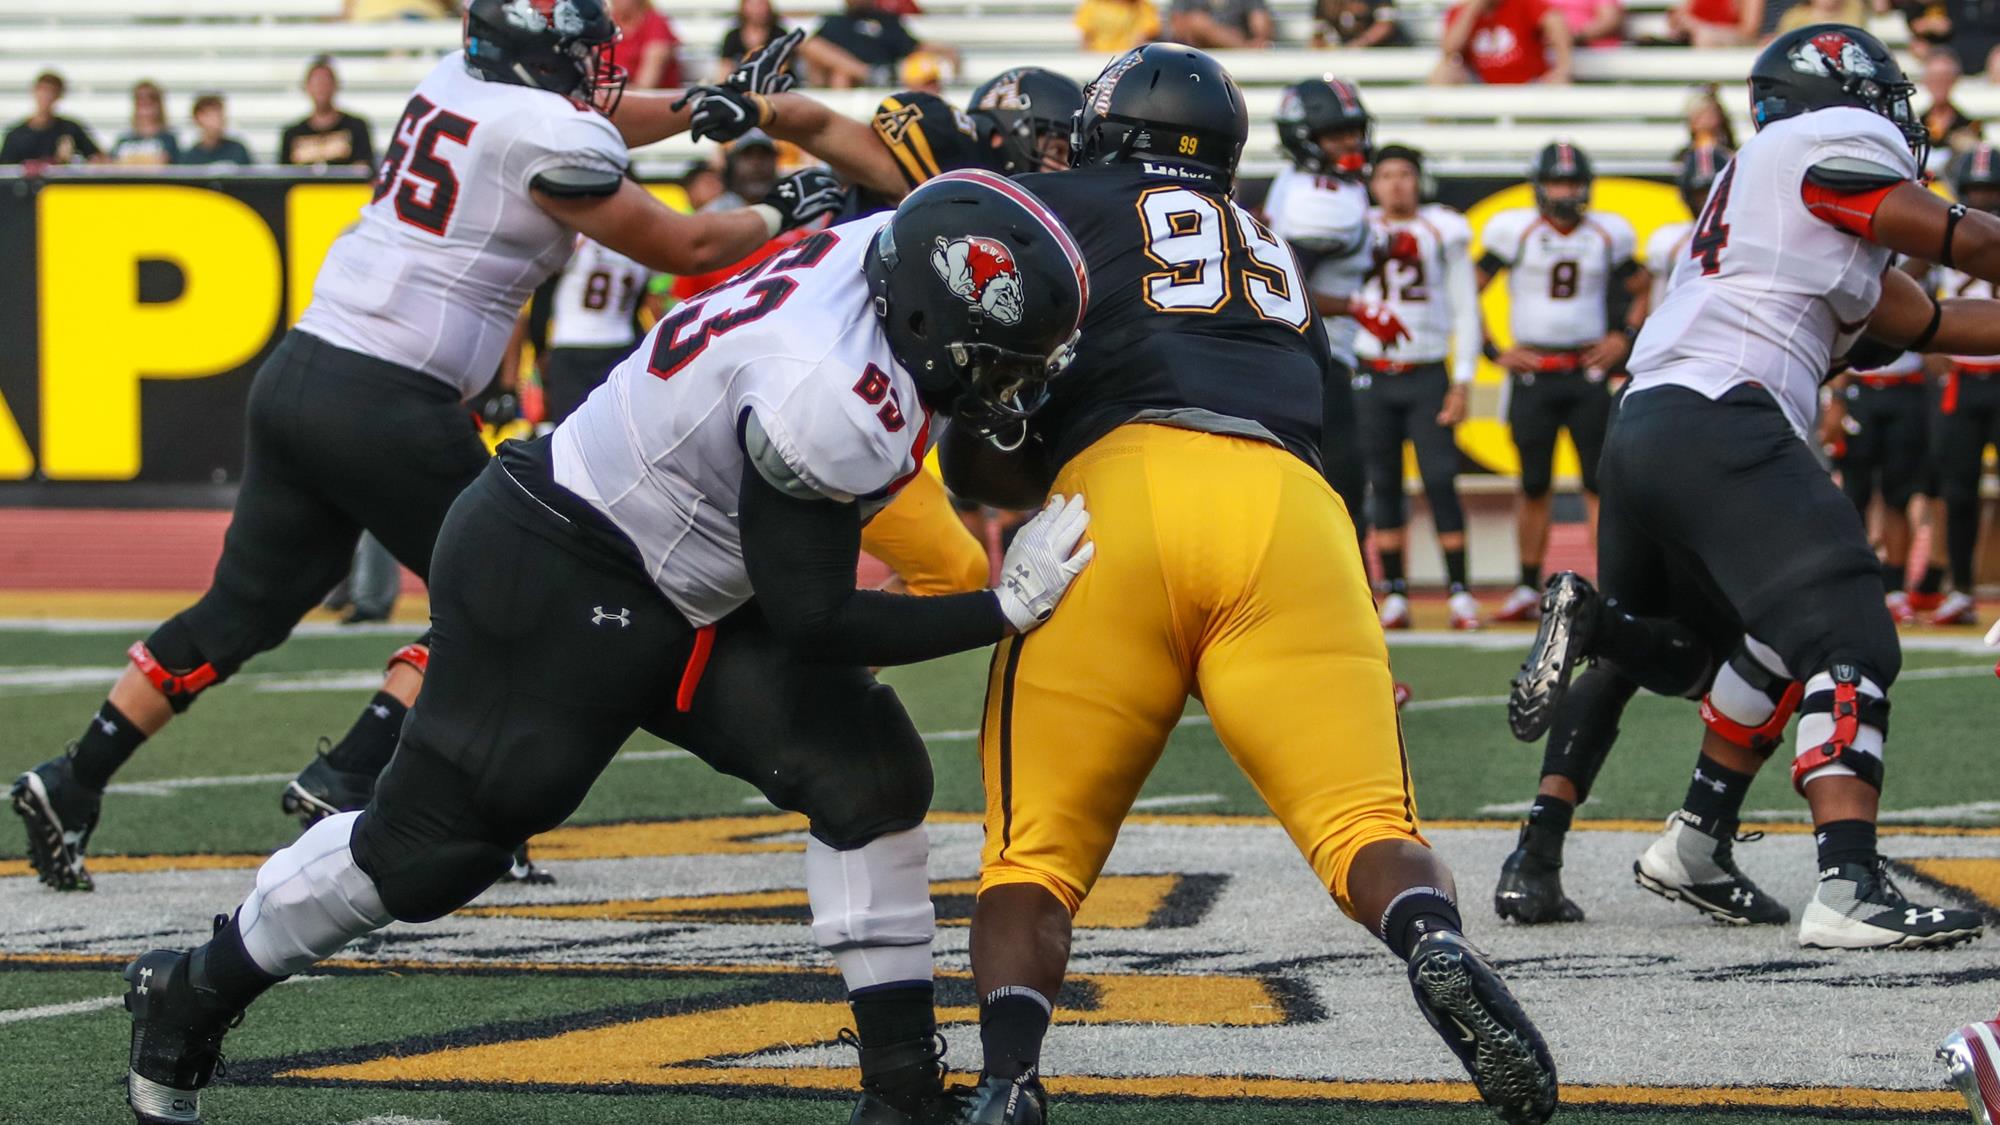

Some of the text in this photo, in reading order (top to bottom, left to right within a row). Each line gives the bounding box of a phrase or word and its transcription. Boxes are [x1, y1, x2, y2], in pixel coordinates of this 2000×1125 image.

[372, 94, 479, 237] 65
[1178, 135, 1198, 155] 99
[980, 243, 1004, 264] GWU
[1136, 185, 1311, 334] 99
[1551, 261, 1578, 299] 8
[583, 270, 635, 312] 81
[647, 229, 841, 381] 63
[852, 362, 906, 432] 63
